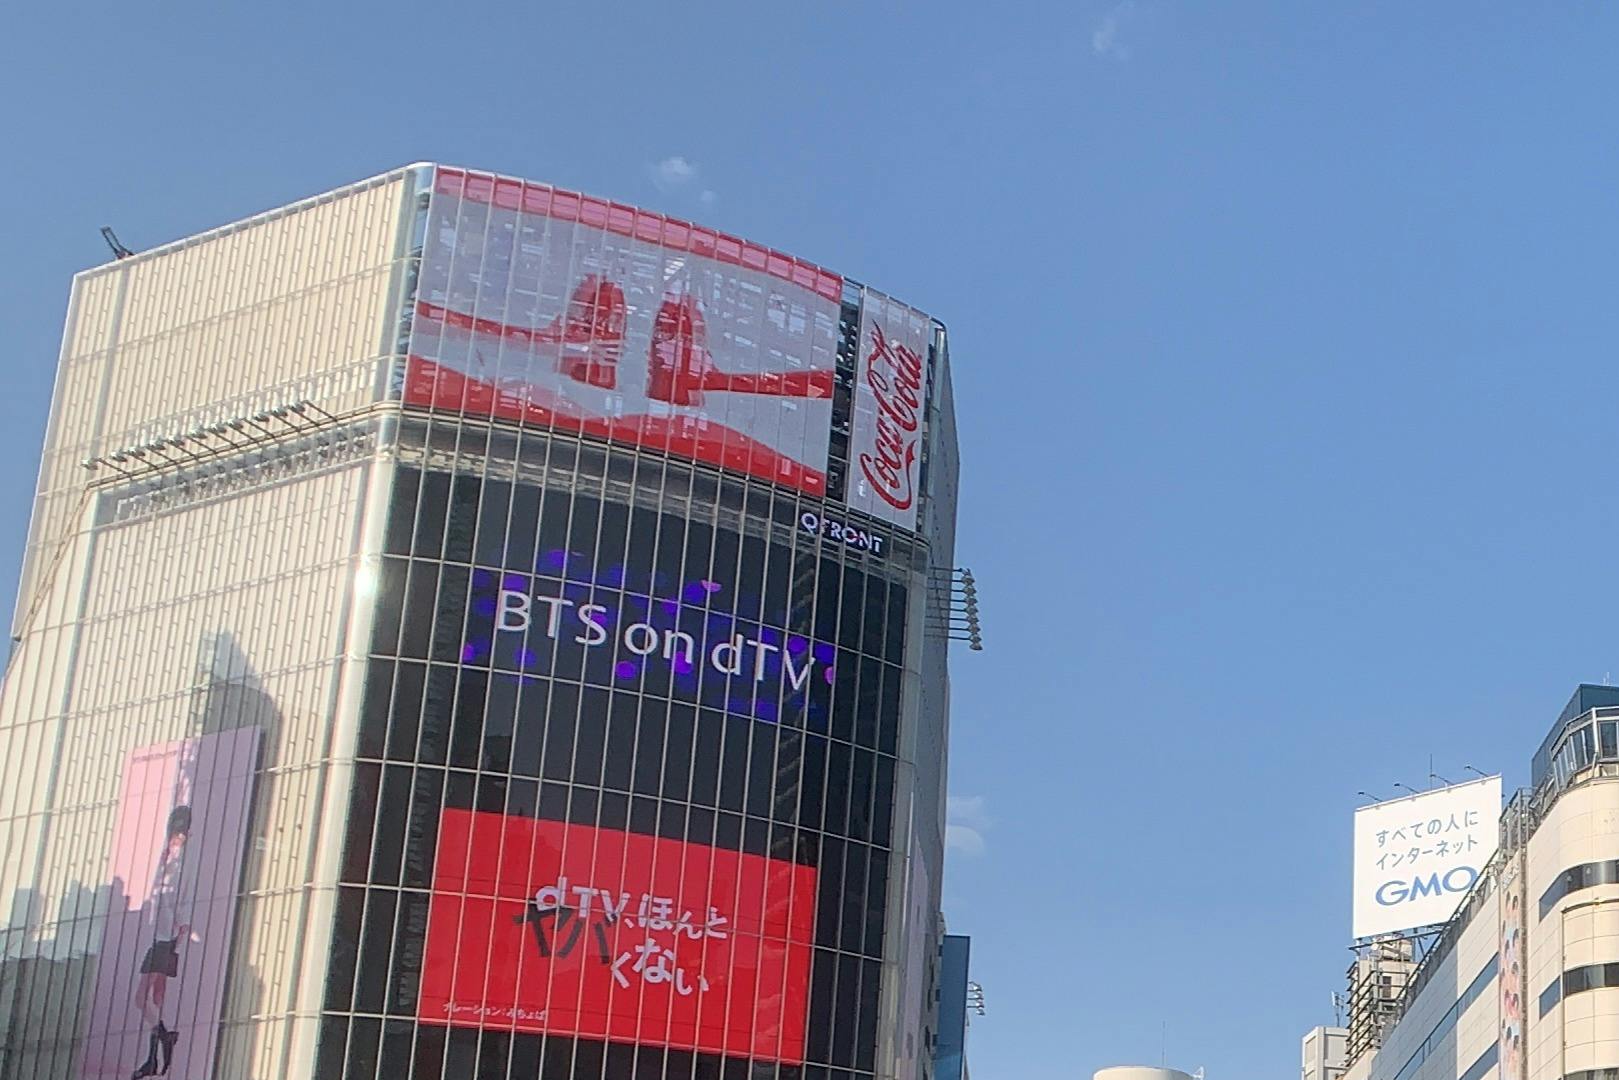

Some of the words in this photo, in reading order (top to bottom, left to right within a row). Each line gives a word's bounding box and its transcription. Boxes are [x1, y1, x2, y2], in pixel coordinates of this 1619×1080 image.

[801, 512, 883, 554] QFRONT
[497, 588, 607, 646] BTS
[624, 622, 693, 664] on
[711, 632, 815, 691] dTV
[1376, 810, 1479, 848] すべての人に
[1376, 834, 1478, 870] インターネット
[1375, 866, 1479, 906] GMO
